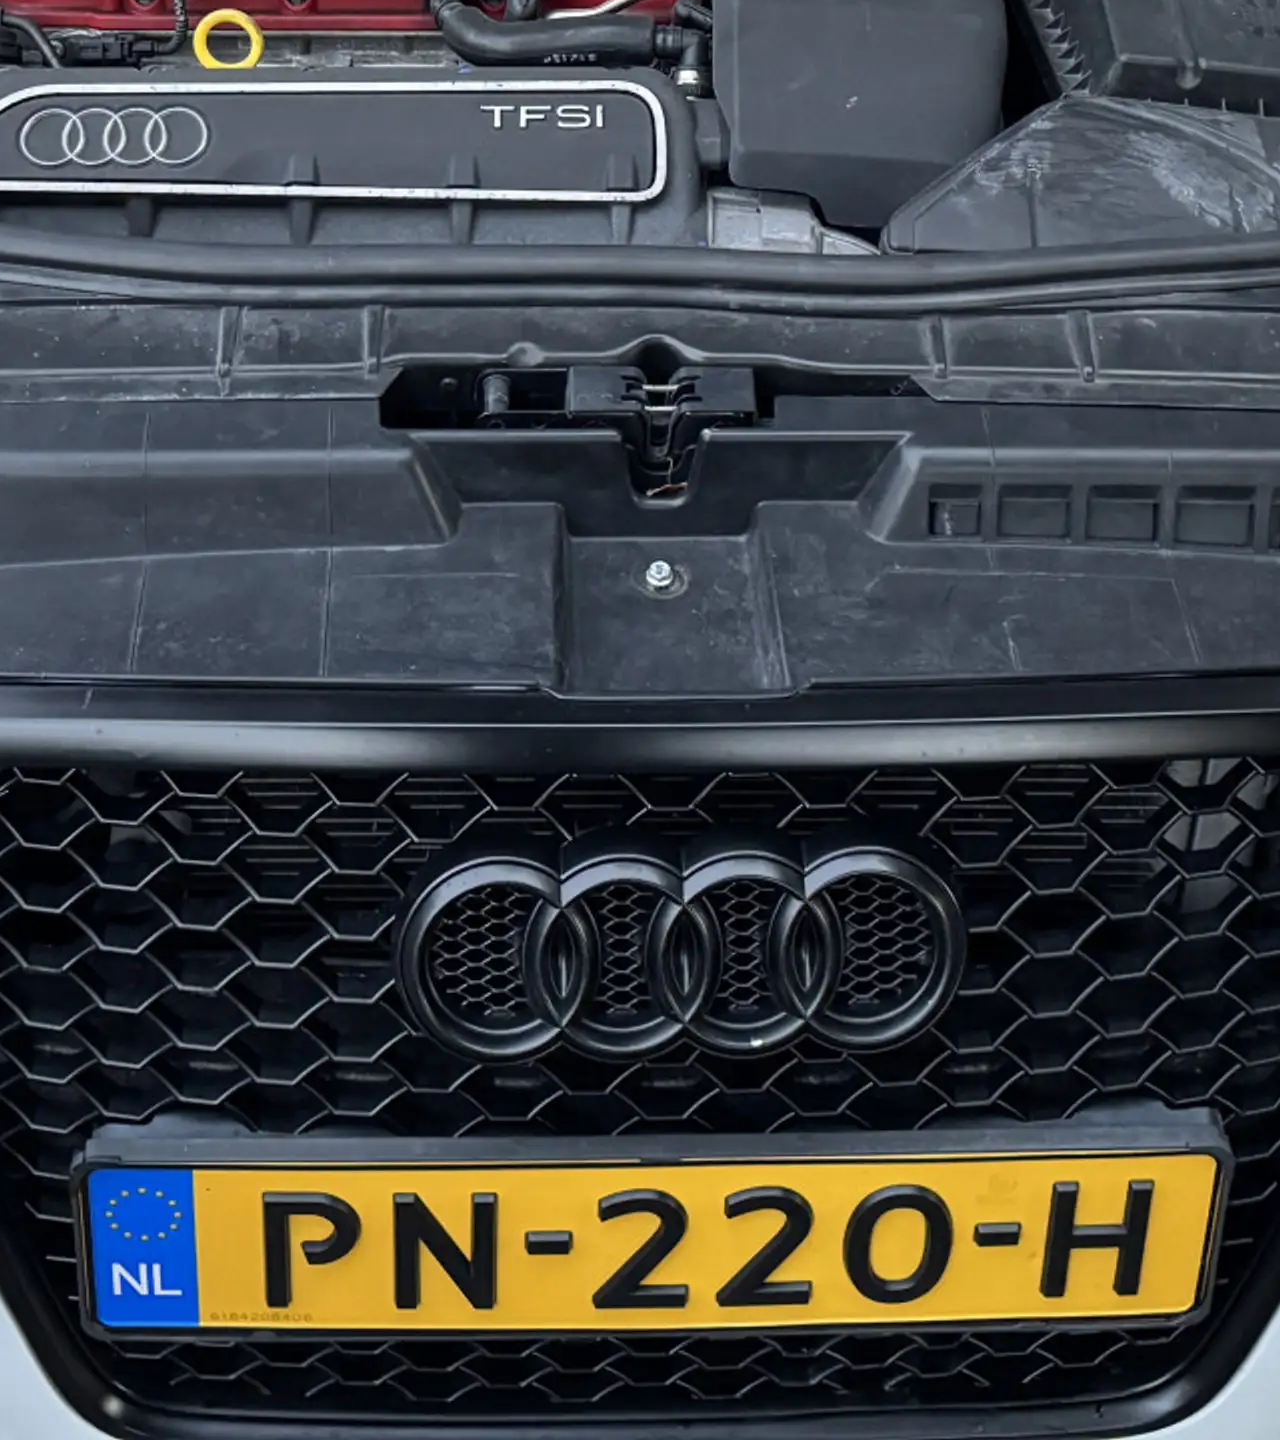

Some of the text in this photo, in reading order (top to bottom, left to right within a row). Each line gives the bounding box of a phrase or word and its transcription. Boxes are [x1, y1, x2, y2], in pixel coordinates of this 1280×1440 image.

[480, 104, 605, 129] TFSI
[261, 1178, 1156, 1310] PN-220-H
[110, 1262, 183, 1297] NL
